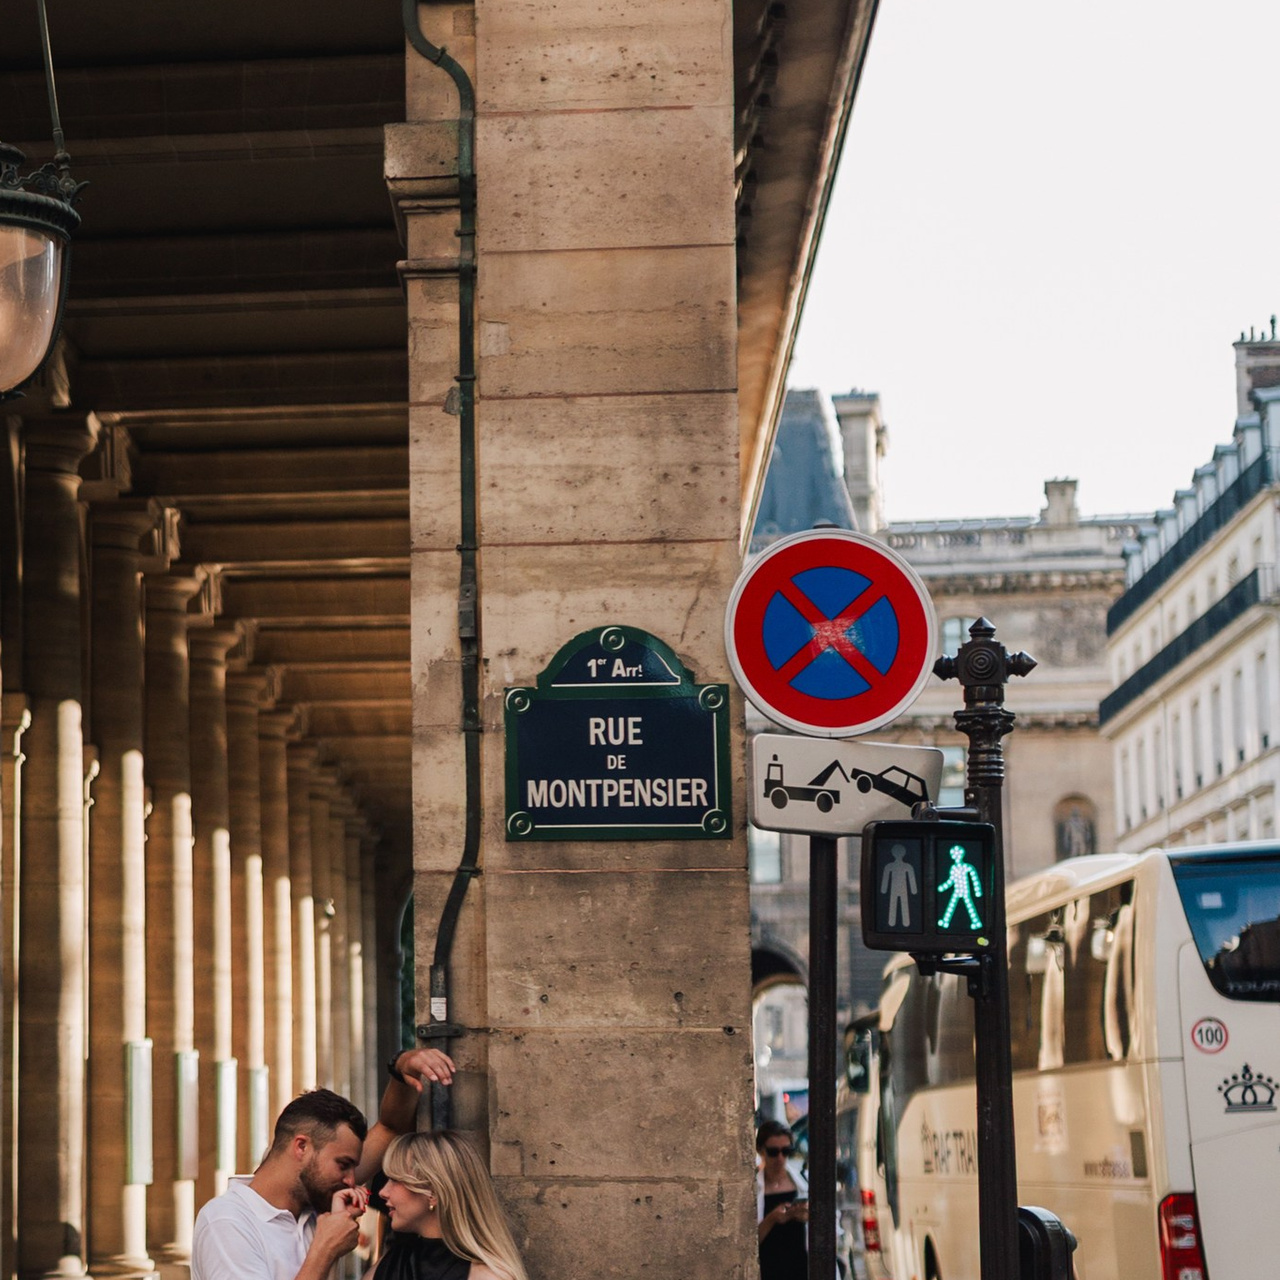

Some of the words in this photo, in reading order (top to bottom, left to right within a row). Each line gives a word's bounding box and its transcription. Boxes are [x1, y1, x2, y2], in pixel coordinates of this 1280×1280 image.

[587, 658, 607, 678] 1er
[589, 717, 643, 746] RUE
[607, 754, 626, 770] DE
[527, 778, 709, 808] MONTPENSIER
[1197, 1026, 1223, 1046] 100
